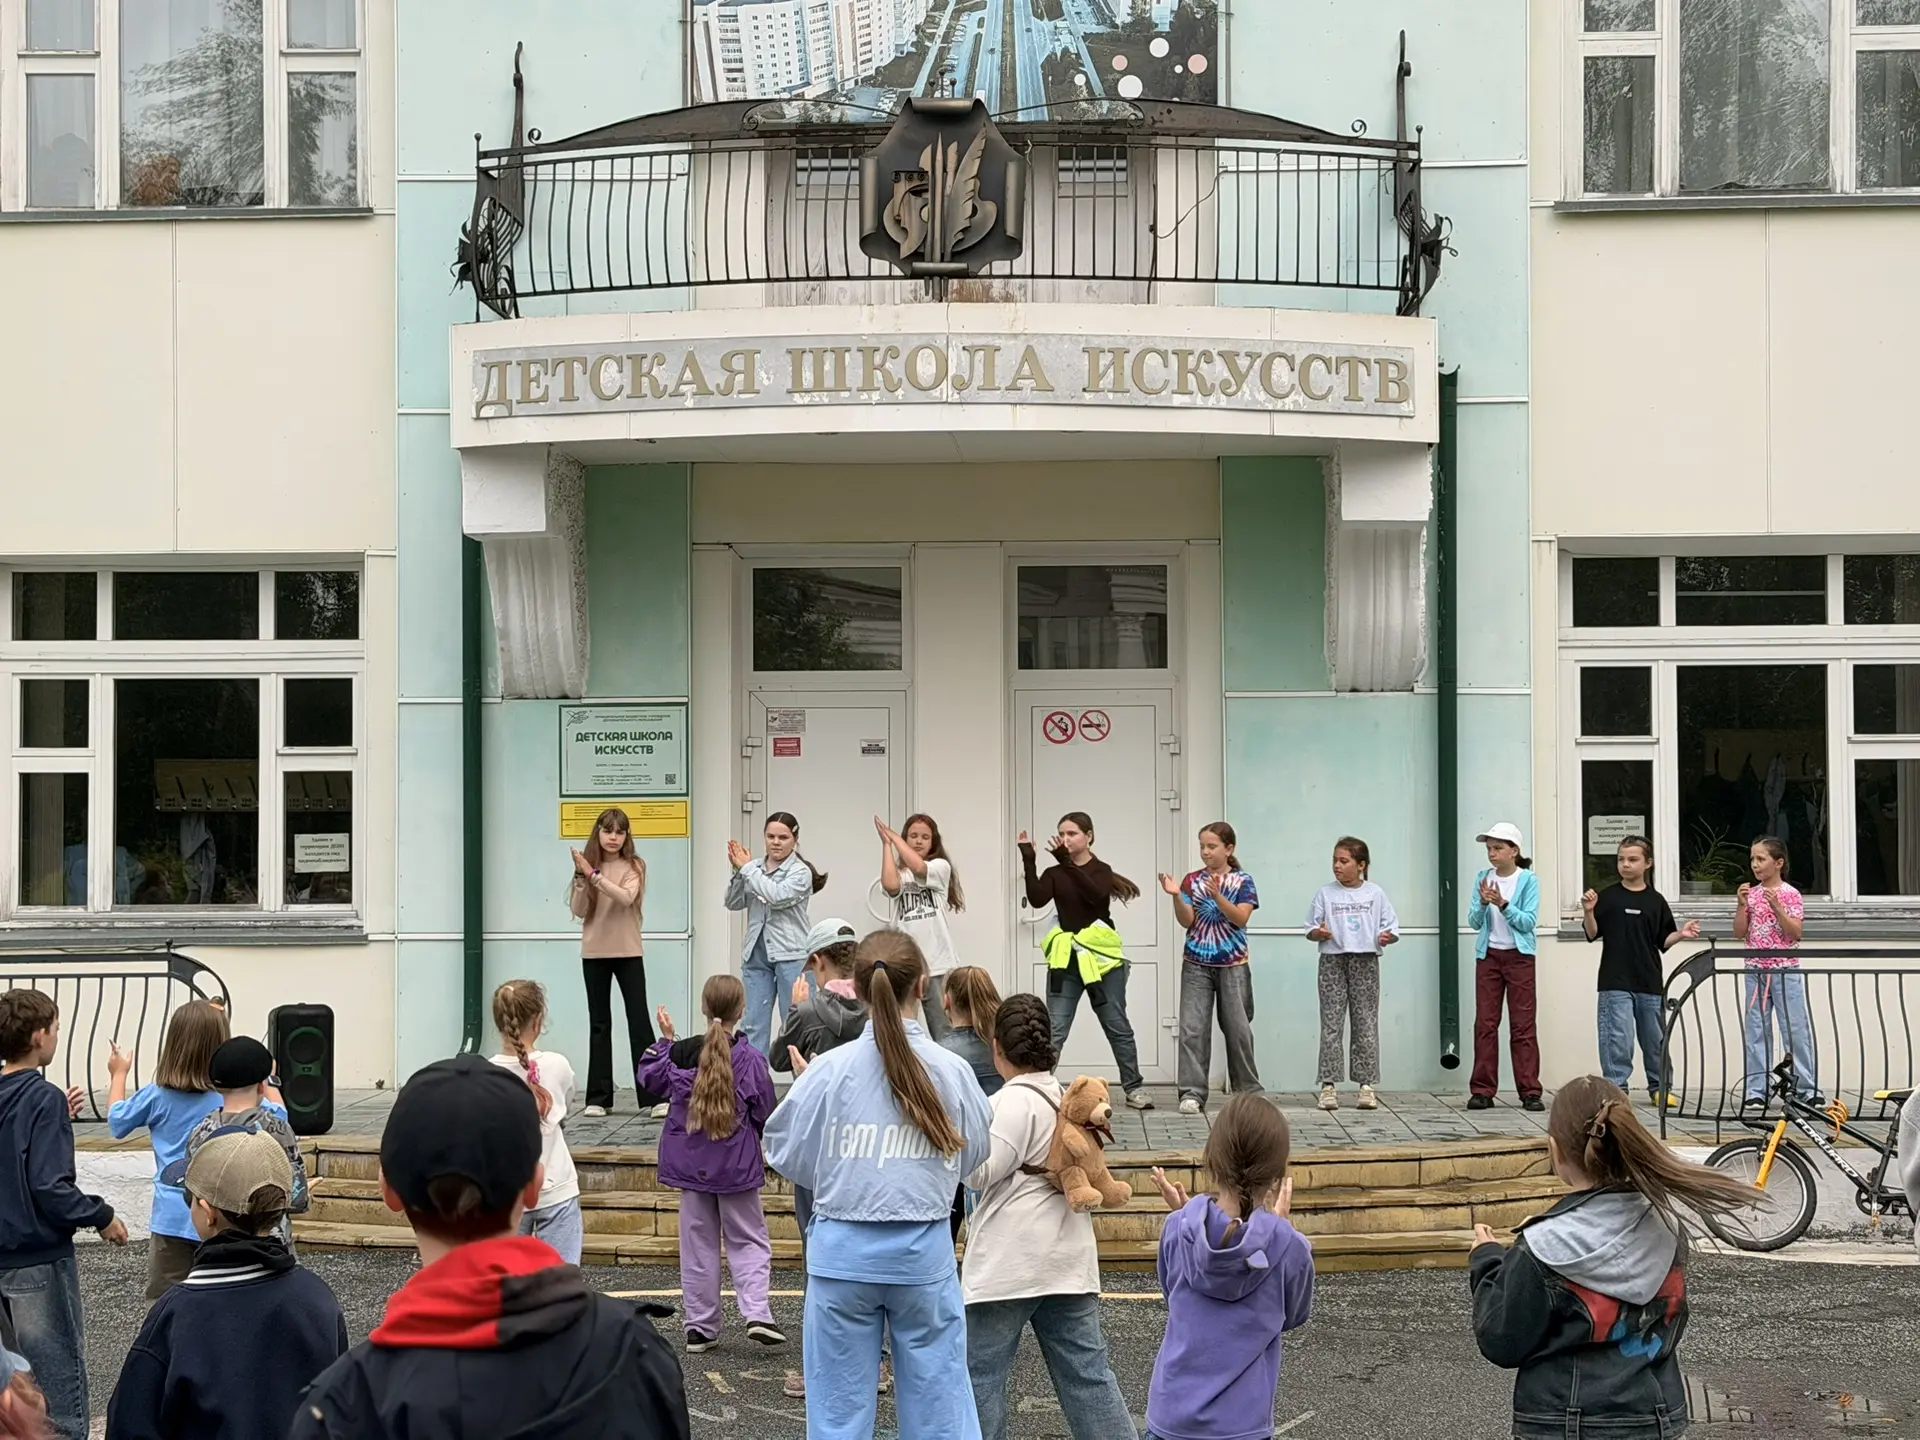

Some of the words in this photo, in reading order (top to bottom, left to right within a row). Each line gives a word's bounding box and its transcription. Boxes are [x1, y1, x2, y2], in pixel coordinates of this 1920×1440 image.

[475, 348, 761, 417] ДЕТСКАЯ
[786, 343, 1055, 394] ШКОЛА
[1082, 346, 1410, 404] ИСКУССТВ
[575, 732, 627, 742] ДЕТСКАЯ
[630, 731, 673, 741] ШКОЛА
[594, 745, 654, 755] ИСКУССТВ
[827, 1116, 838, 1159] i
[839, 1123, 878, 1159] am
[1795, 1118, 1859, 1178] FORWARD
